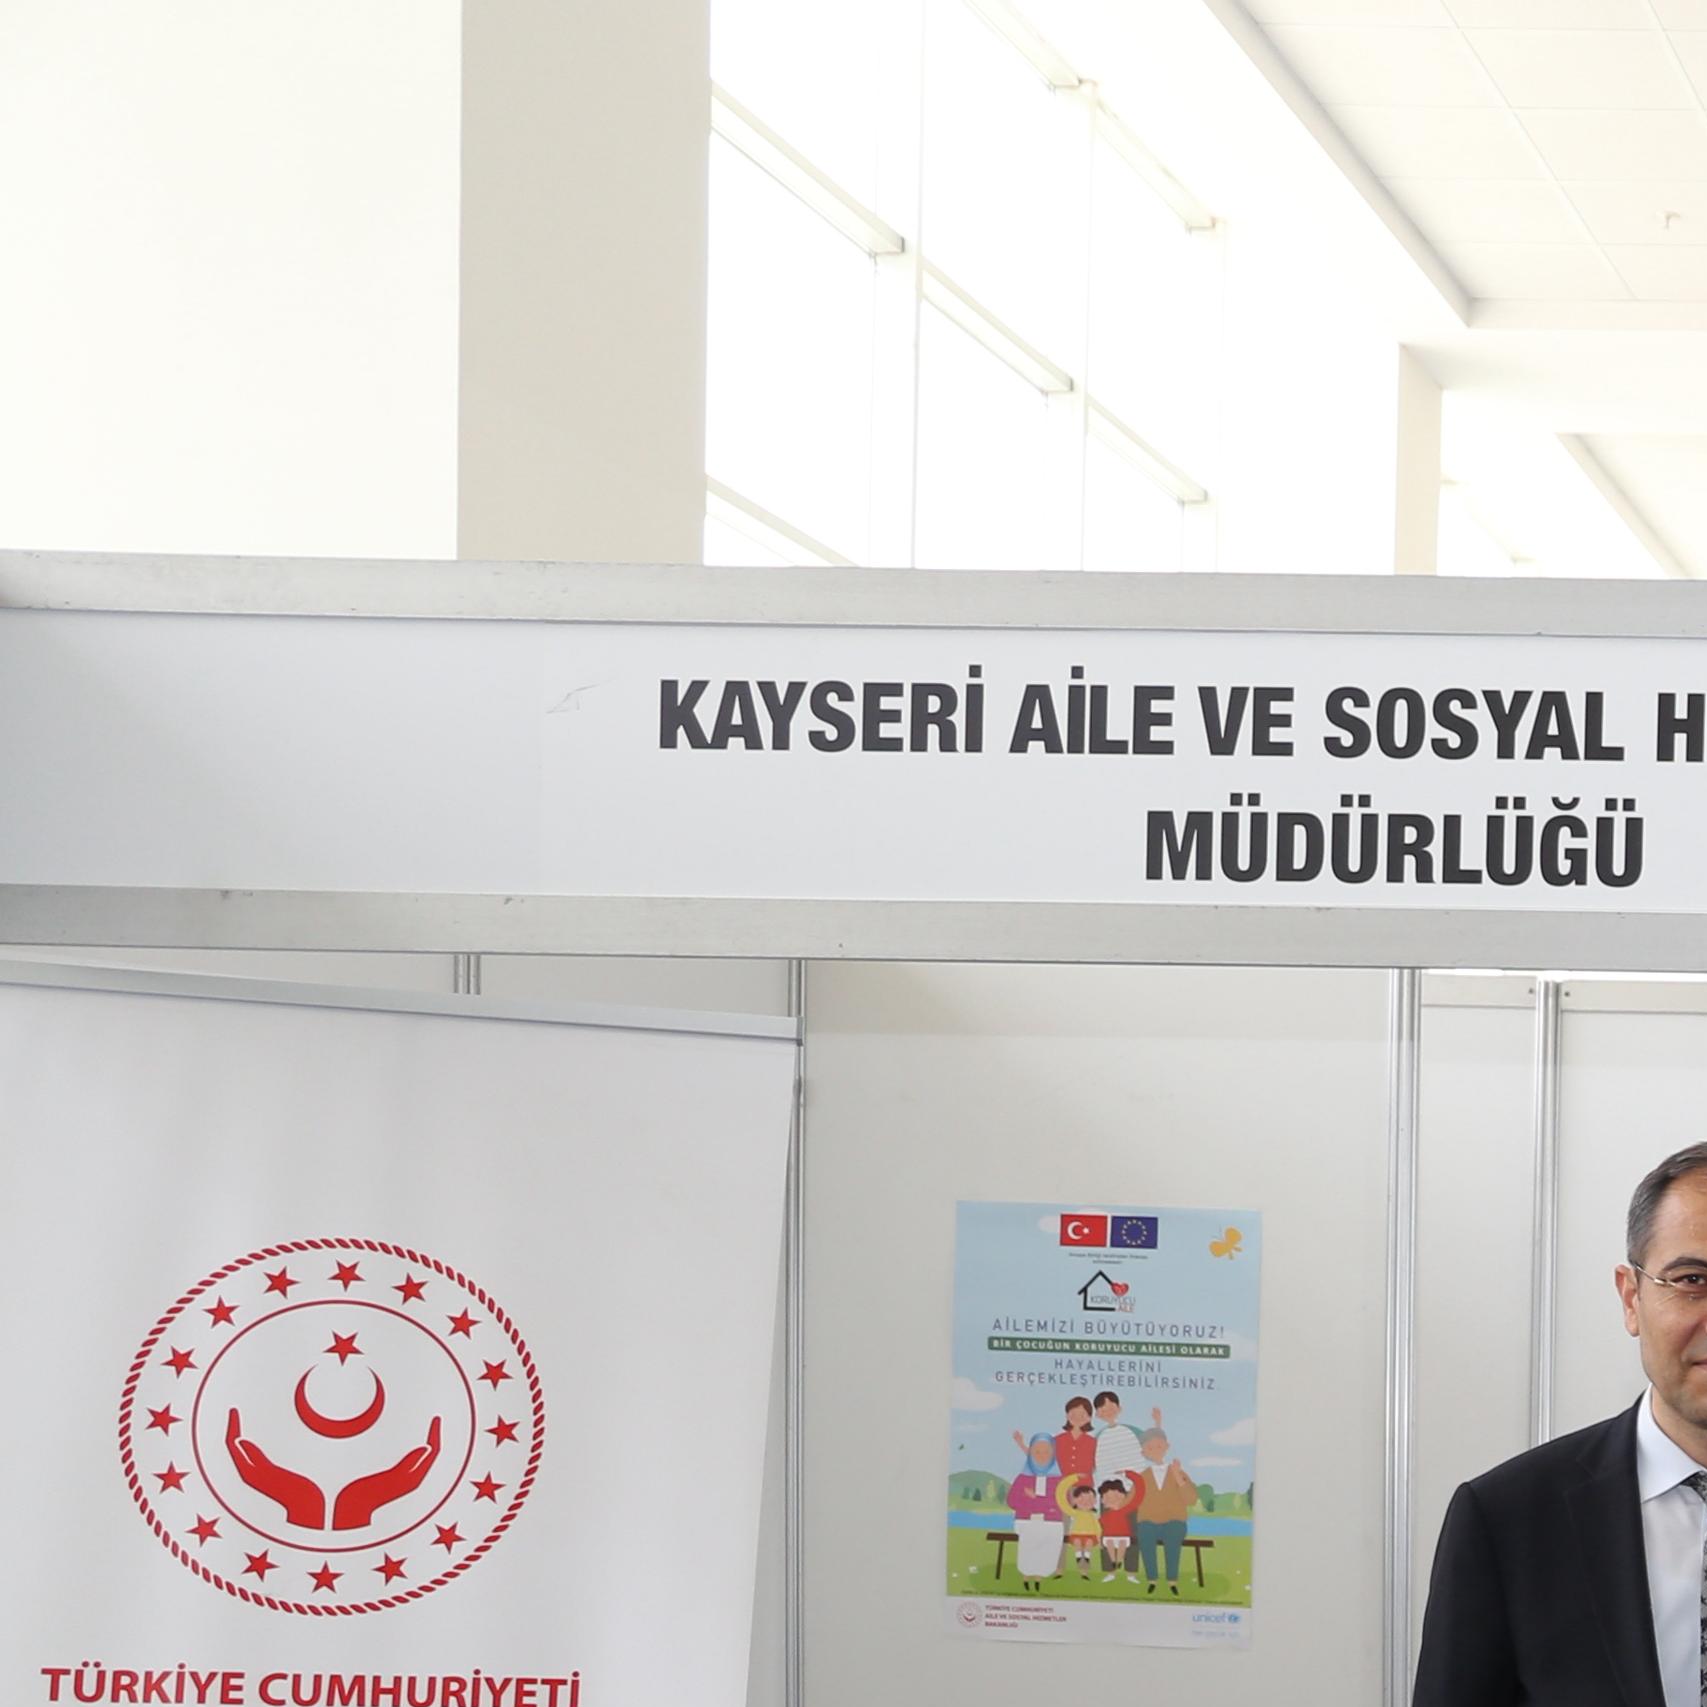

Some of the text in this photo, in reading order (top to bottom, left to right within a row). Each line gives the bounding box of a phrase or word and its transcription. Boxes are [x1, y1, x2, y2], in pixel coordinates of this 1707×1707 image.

[659, 665, 985, 753] KAYSERİ
[1008, 666, 1175, 756] AİLE
[1198, 686, 1295, 757] VE
[1323, 686, 1625, 762] SOSYAL
[1146, 791, 1644, 888] MÜDÜRLÜĞÜ
[992, 1317, 1225, 1339] AİLEMİZİ BÜYÜTÜYORUZ!
[992, 1338, 1225, 1356] BİR ÇOCUĞUN KORUYUCU AİLESİ OLARAK
[1054, 1358, 1162, 1373] HAYALLERİNİ
[995, 1370, 1216, 1391] GERÇEKLEŞTİREBİLİRSİNİZ
[1192, 1612, 1226, 1624] unicef
[41, 1661, 245, 1706] TÜRKİYE
